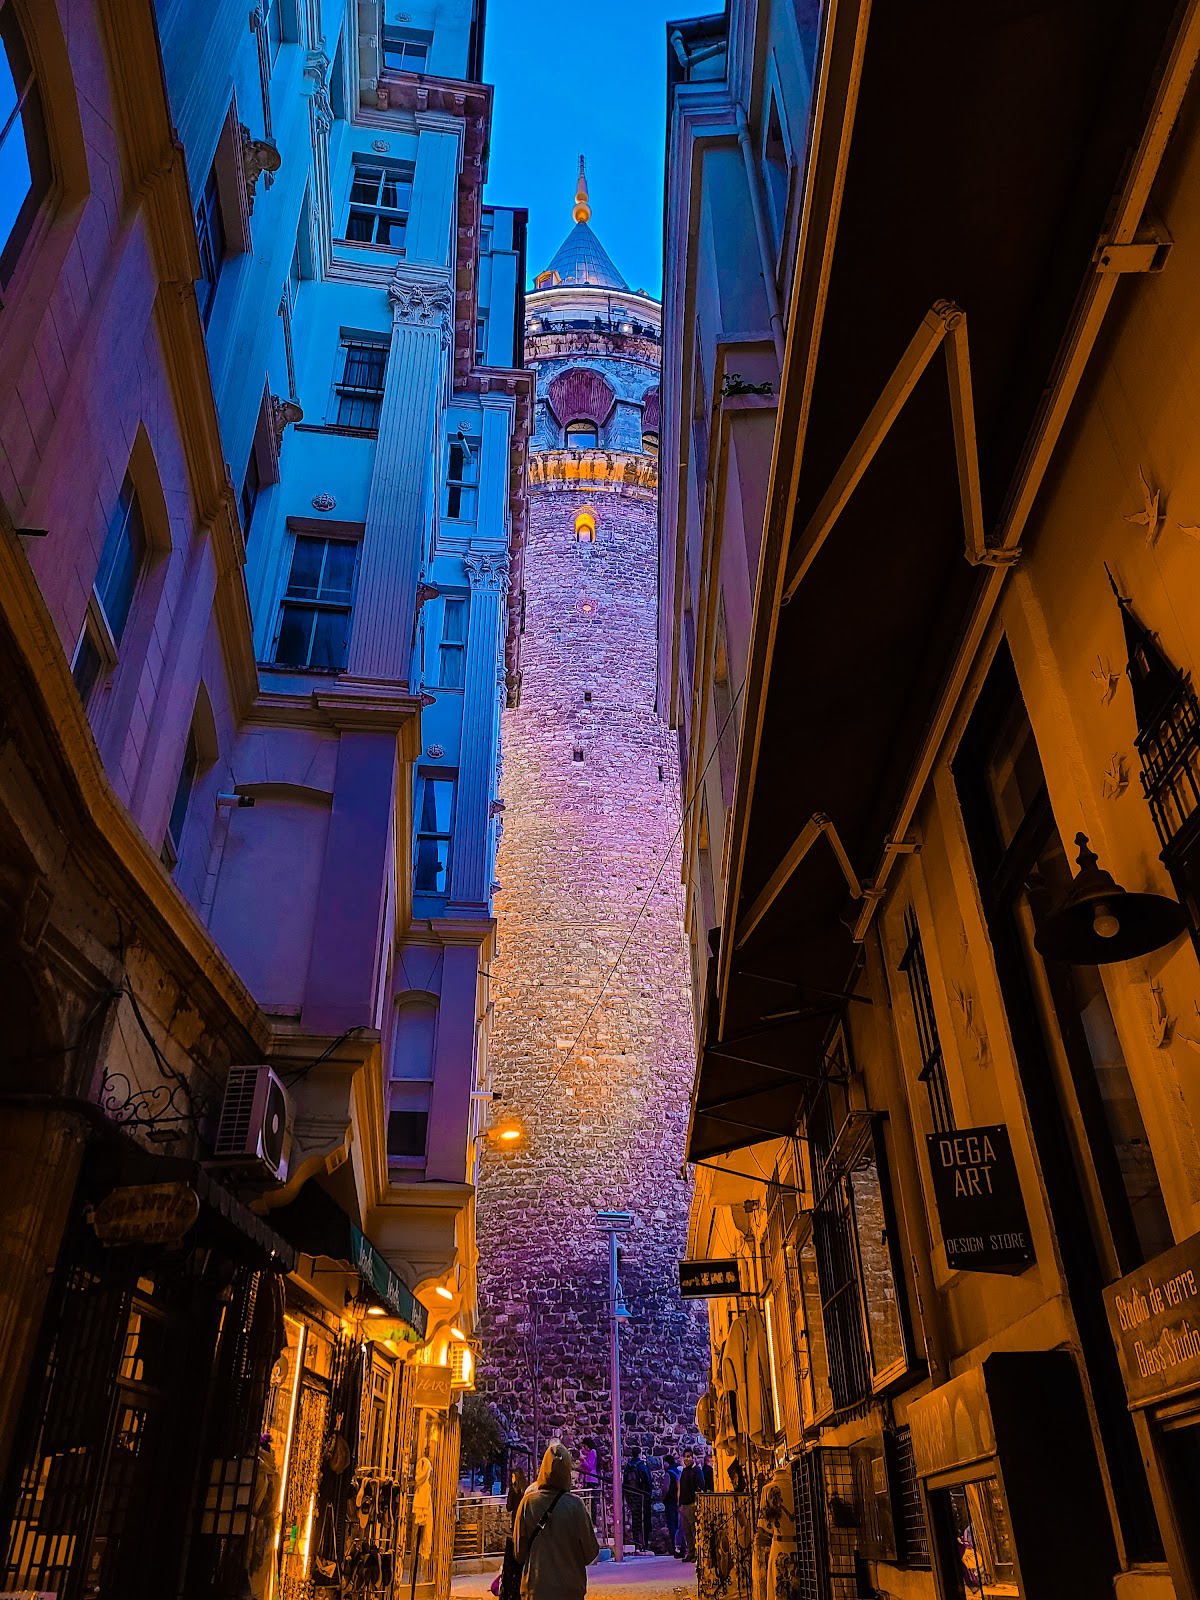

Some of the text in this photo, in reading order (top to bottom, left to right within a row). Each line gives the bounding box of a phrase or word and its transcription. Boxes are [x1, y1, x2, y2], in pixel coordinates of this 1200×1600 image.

[940, 1135, 997, 1167] DEGA
[955, 1166, 993, 1197] ART
[946, 1233, 1027, 1254] DESIGN STORE
[1115, 1269, 1198, 1331] Studio de verre
[1134, 1340, 1167, 1378] Glass
